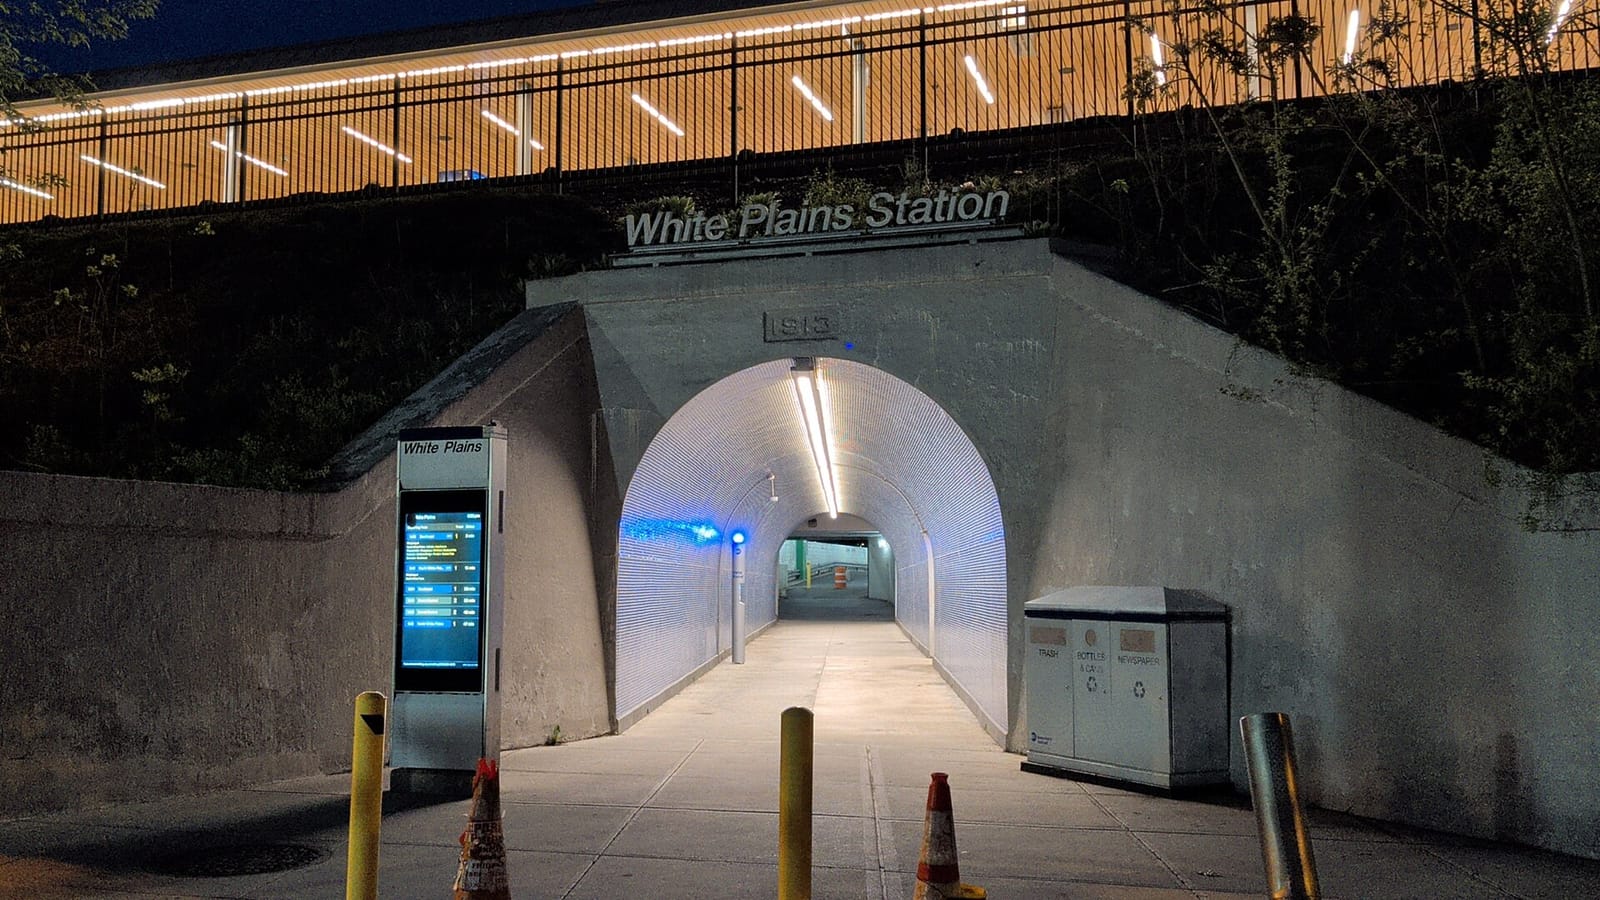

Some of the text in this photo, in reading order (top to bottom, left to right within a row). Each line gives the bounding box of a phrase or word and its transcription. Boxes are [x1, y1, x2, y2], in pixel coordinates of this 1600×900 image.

[626, 187, 1010, 246] White Plains Station
[404, 440, 483, 454] White Plains
[1039, 649, 1059, 658] TRASH
[1077, 651, 1106, 661] BOTTLES
[1117, 655, 1160, 666] NEWSPAPER
